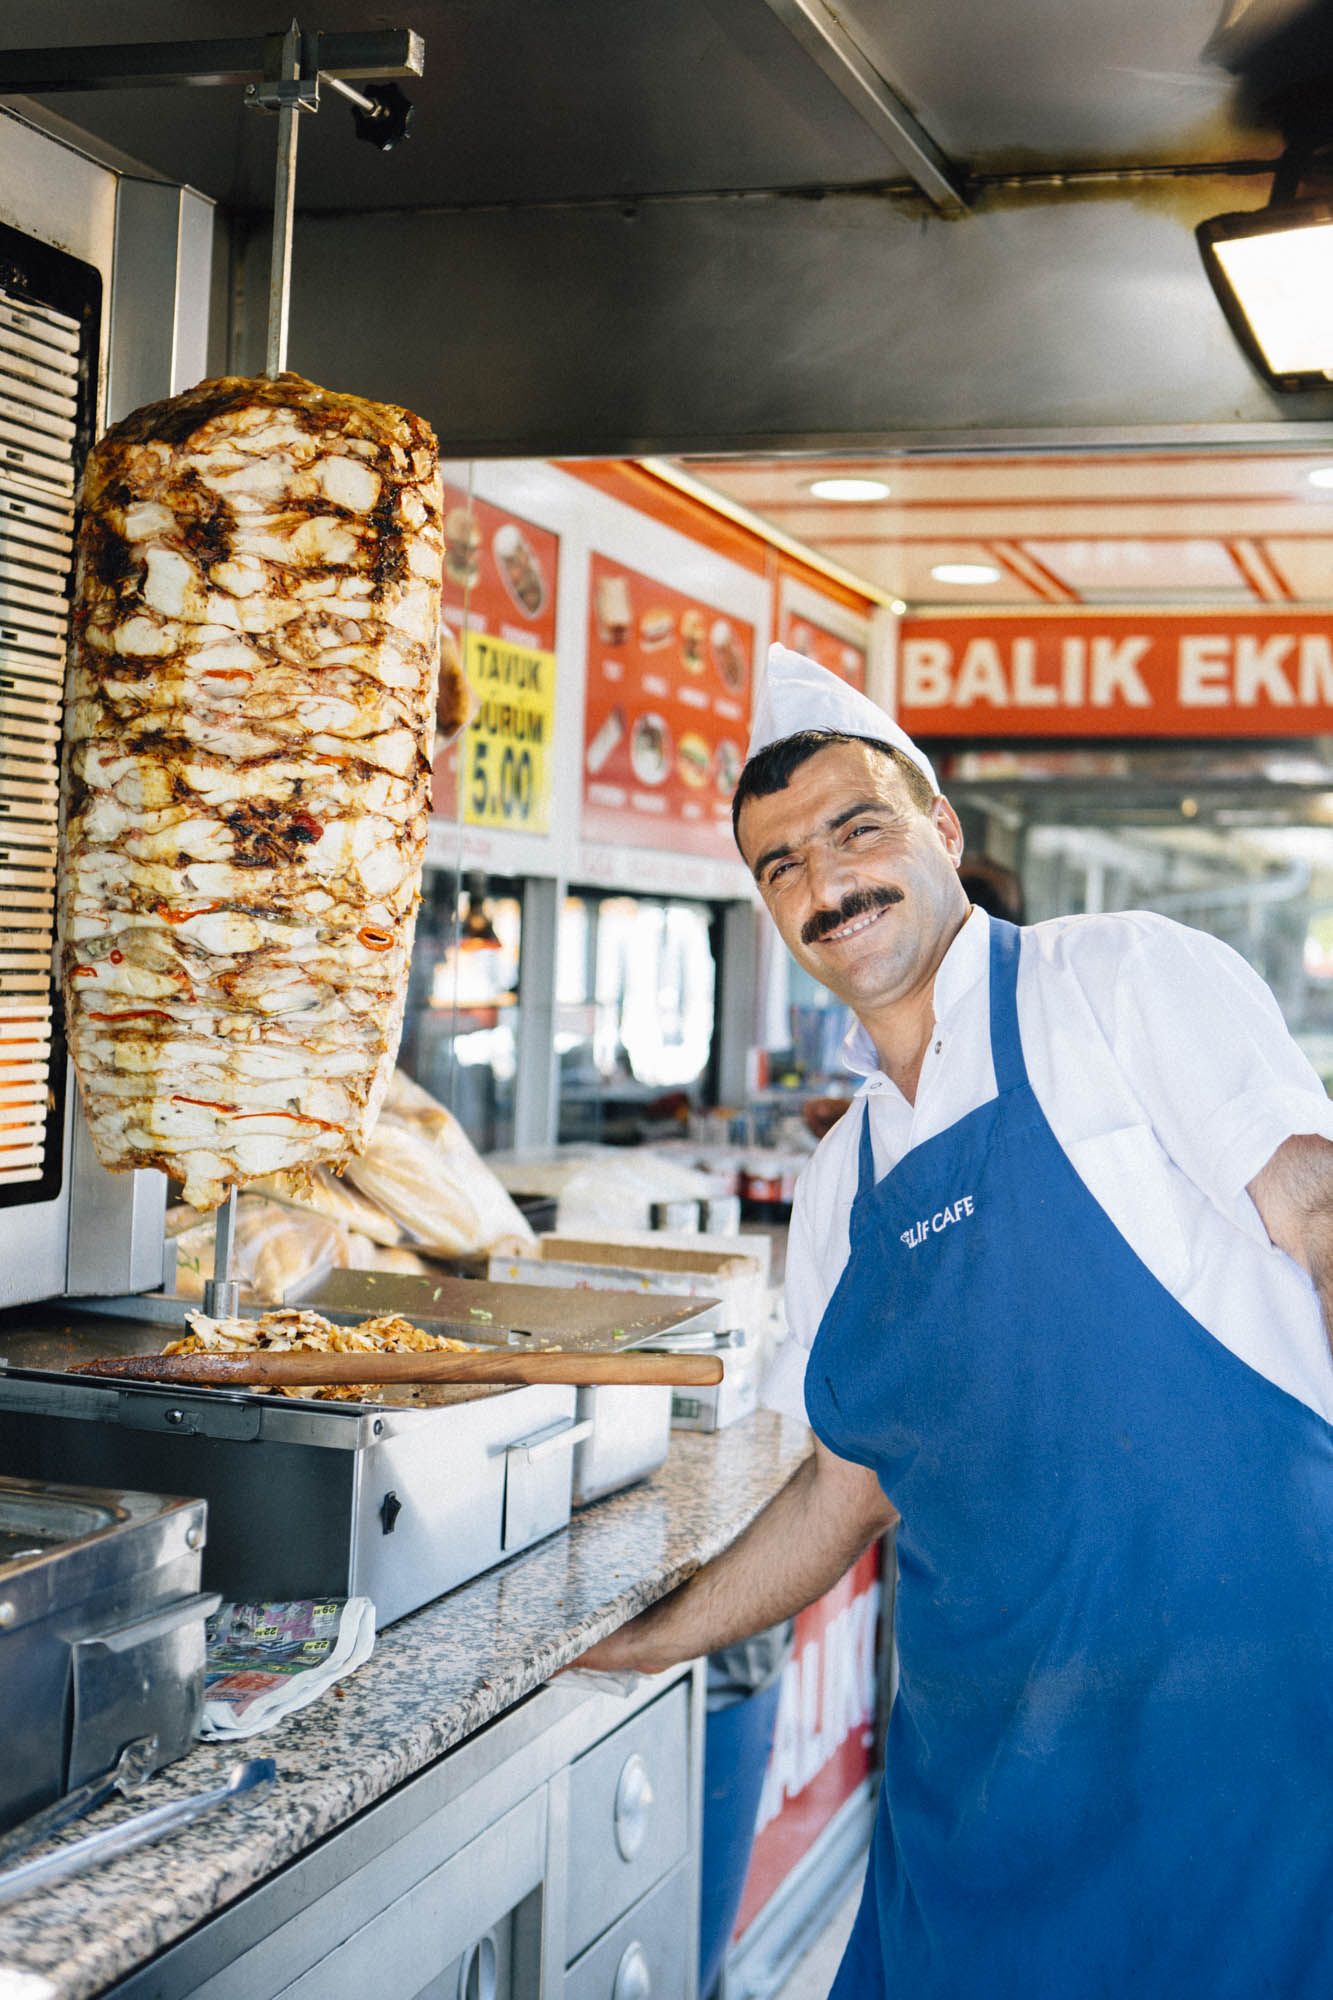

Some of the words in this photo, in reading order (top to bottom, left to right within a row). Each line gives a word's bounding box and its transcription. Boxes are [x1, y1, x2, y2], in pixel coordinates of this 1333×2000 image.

[477, 643, 542, 693] TAVUK
[903, 637, 1153, 709] BALIK
[471, 741, 533, 821] 5.00
[932, 1195, 974, 1232] CAFE
